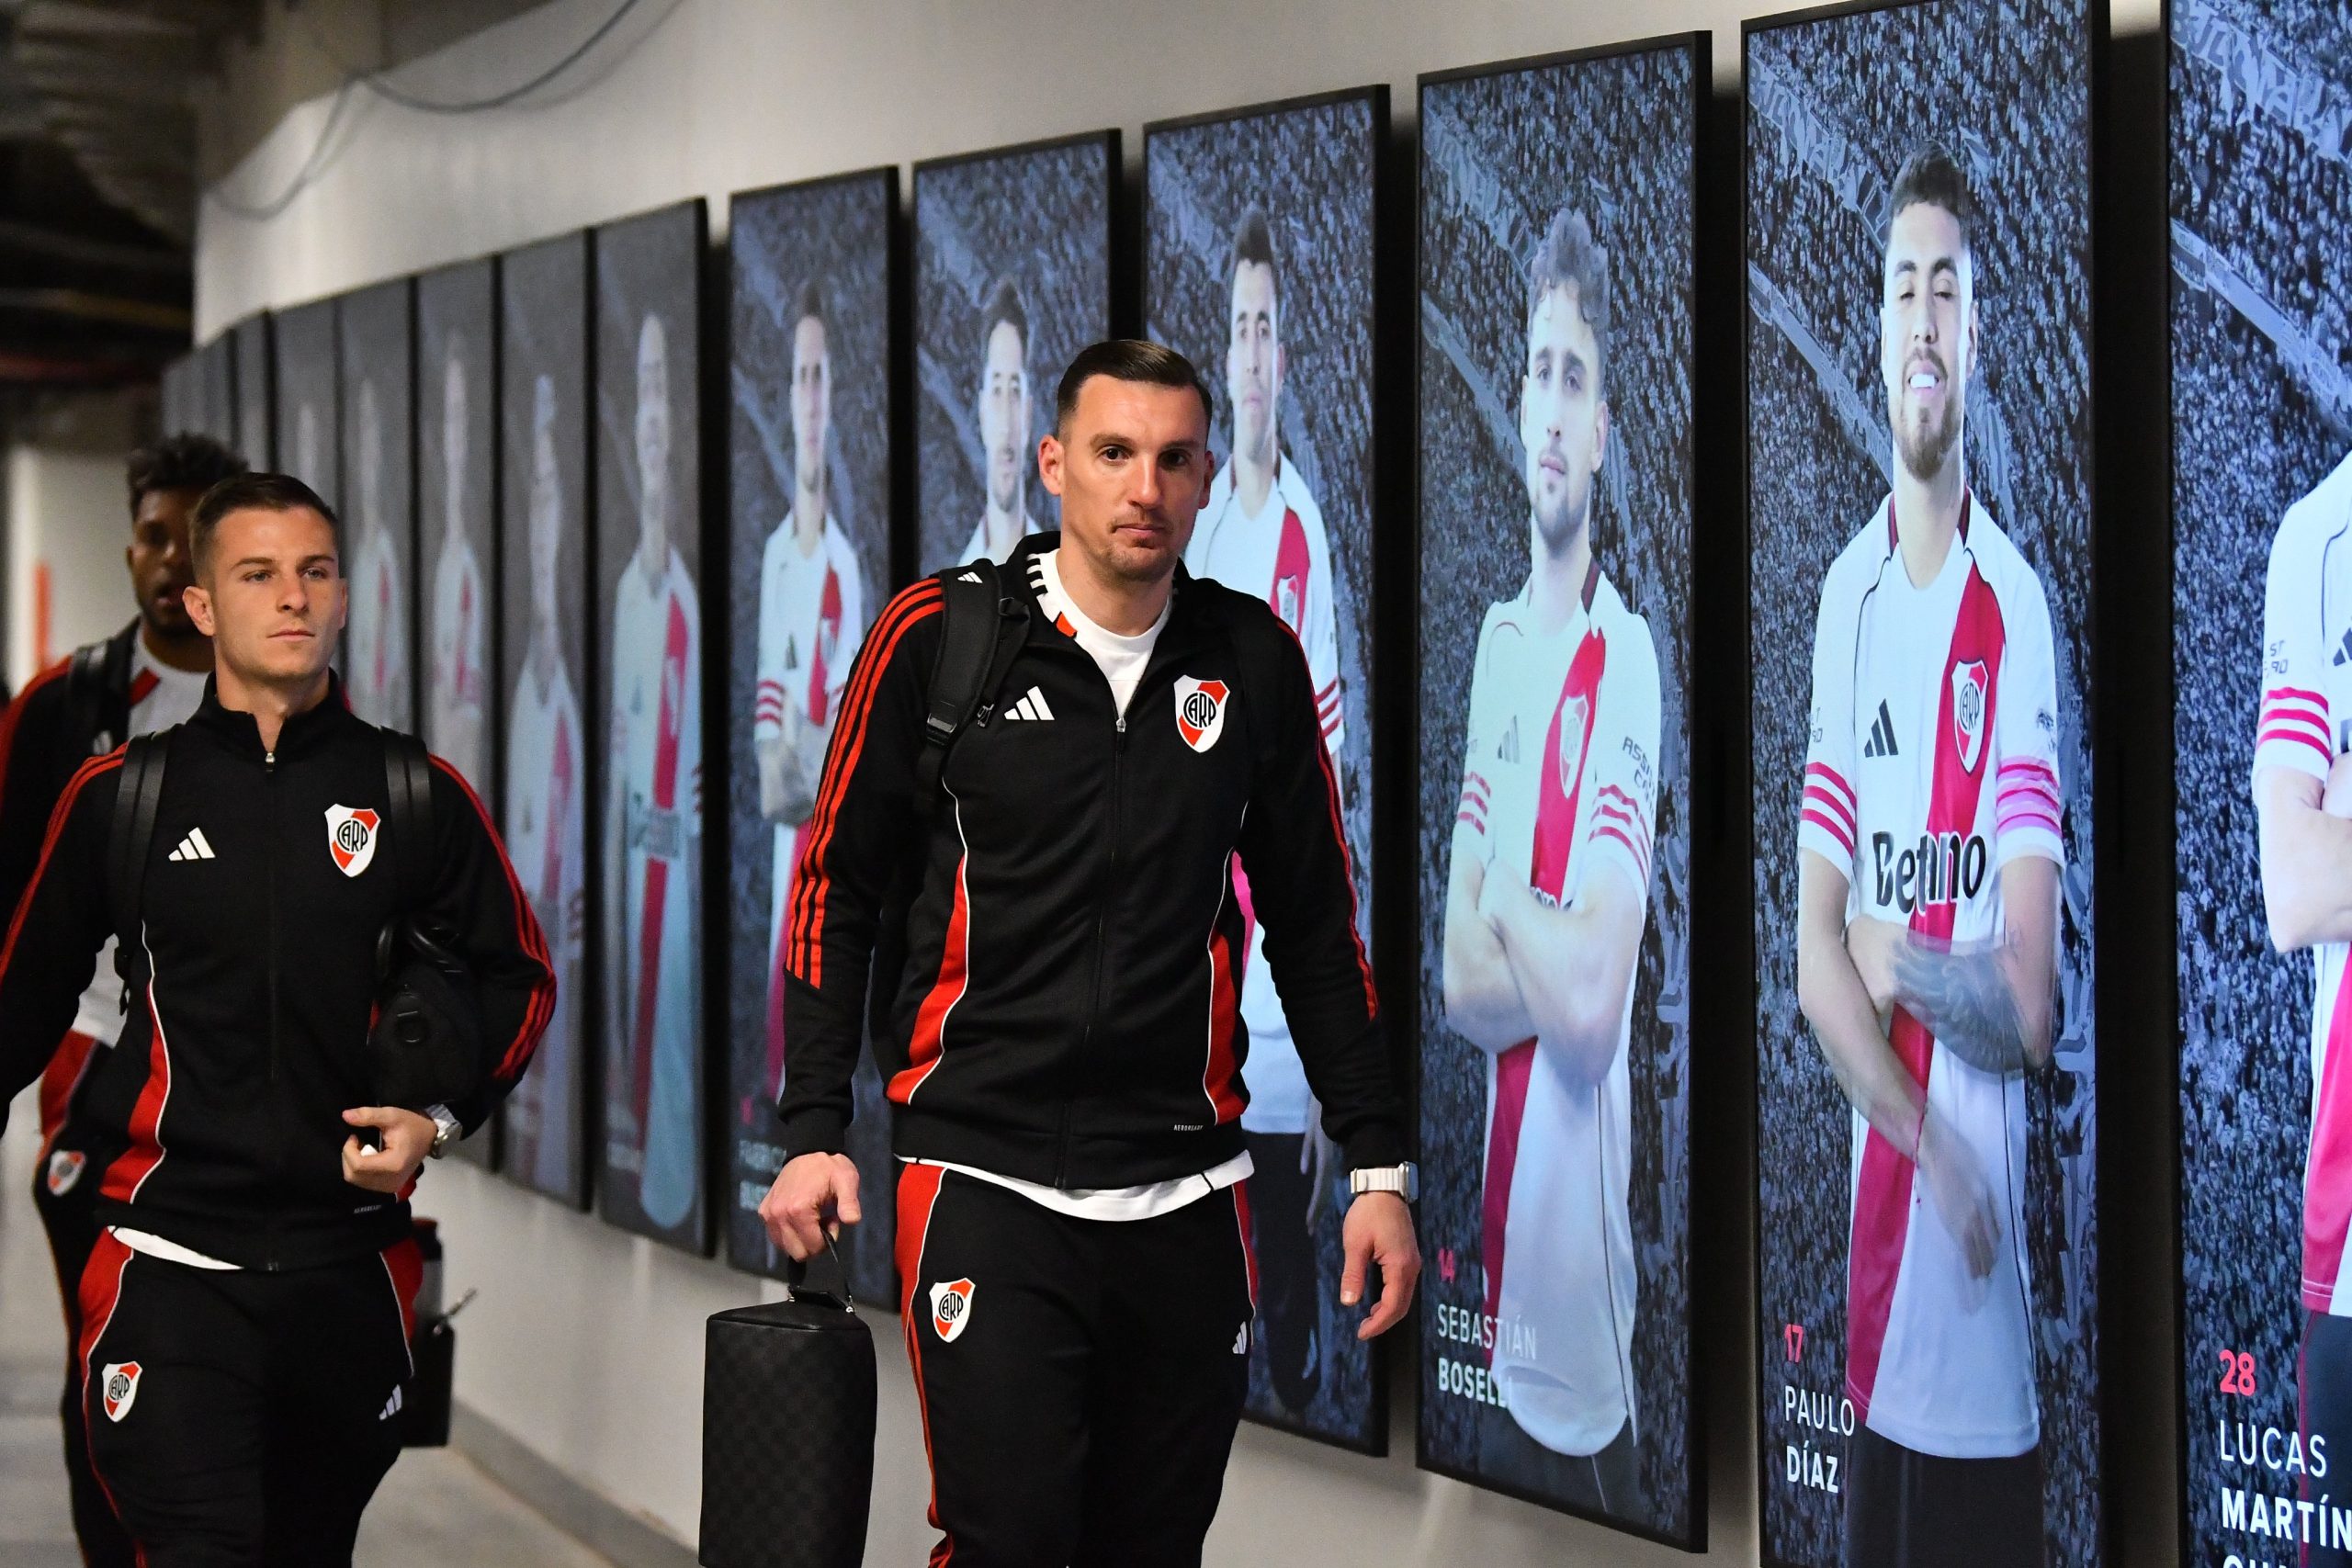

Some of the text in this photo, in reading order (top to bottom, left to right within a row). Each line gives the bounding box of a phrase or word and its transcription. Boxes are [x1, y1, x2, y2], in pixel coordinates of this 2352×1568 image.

[1183, 692, 1216, 728] CARP
[336, 819, 368, 852] CARP
[1438, 1247, 1455, 1283] 14
[938, 1292, 964, 1321] CARP
[1438, 1303, 1537, 1360] SEBASTIÁN
[1784, 1324, 1804, 1363] 17
[108, 1374, 130, 1400] CARP
[2219, 1348, 2256, 1396] 28
[1784, 1385, 1855, 1437] PAULO
[1786, 1439, 1838, 1494] DÍAZ
[2220, 1419, 2326, 1477] LUCAS
[2222, 1486, 2352, 1552] MARTÍN
